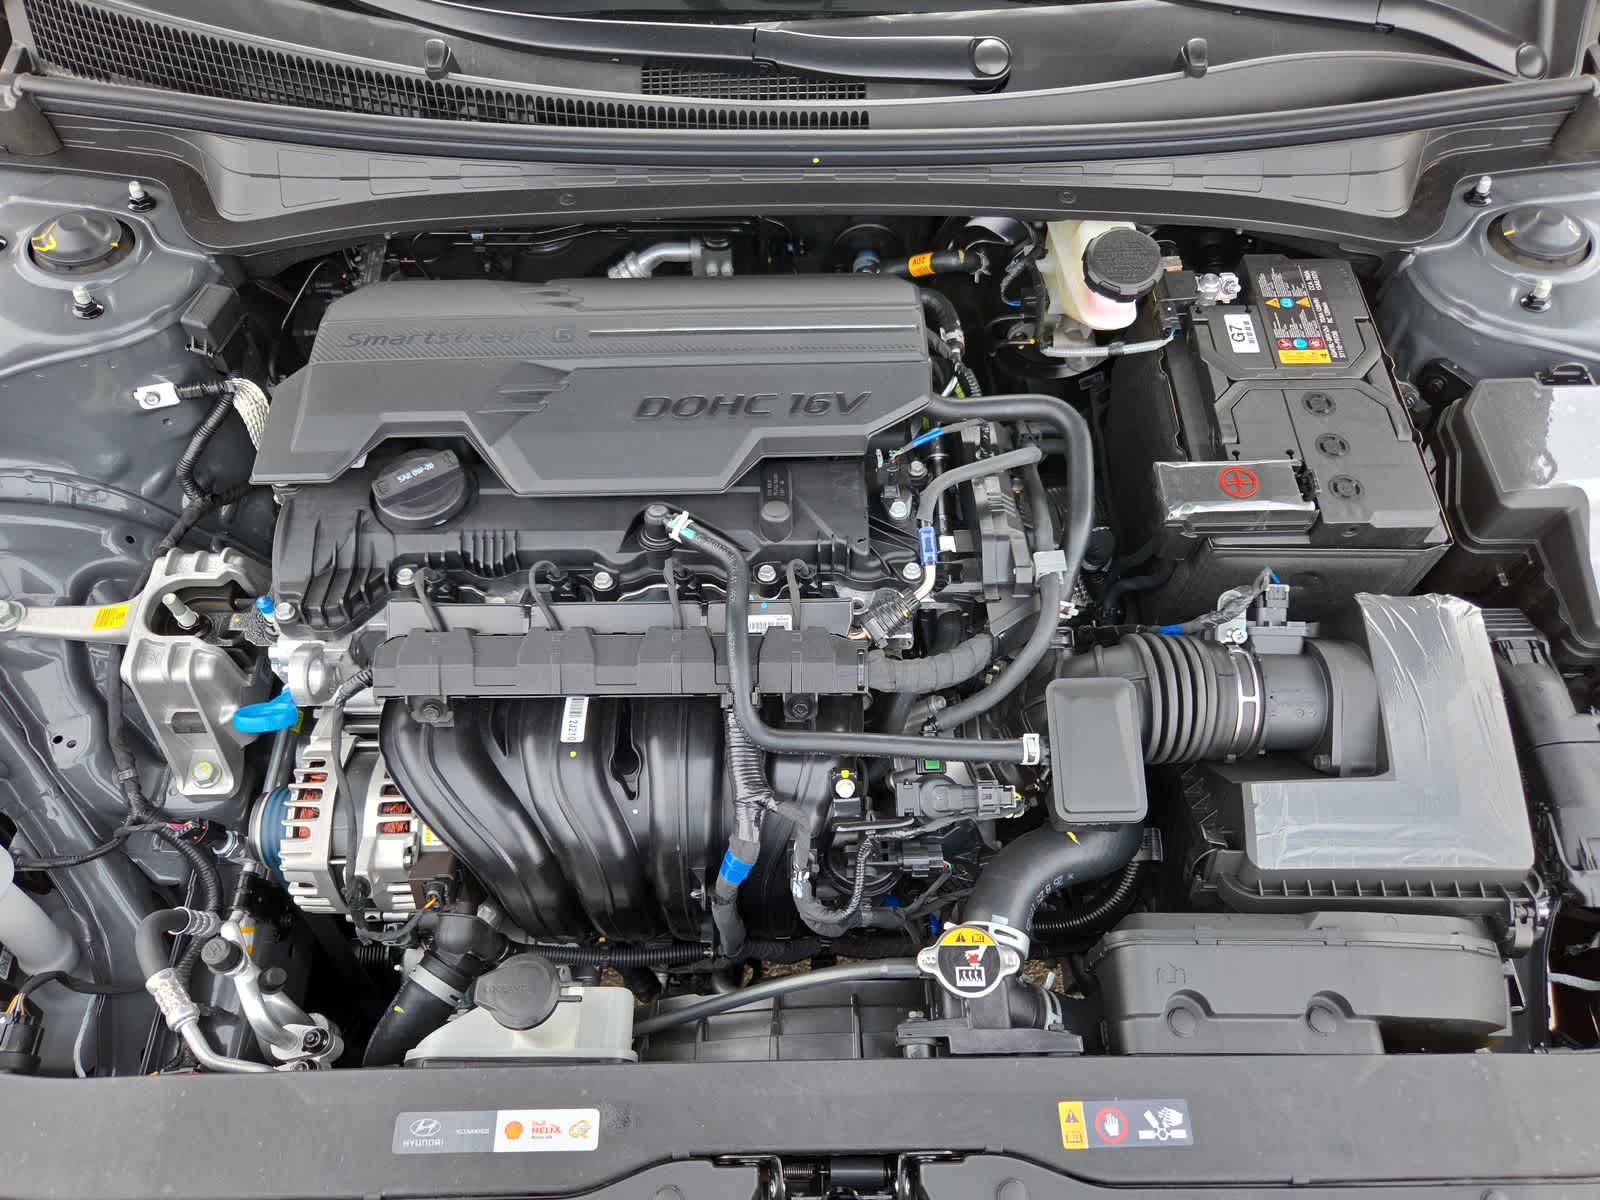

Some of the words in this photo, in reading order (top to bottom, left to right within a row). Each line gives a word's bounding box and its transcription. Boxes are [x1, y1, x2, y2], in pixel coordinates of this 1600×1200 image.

[1231, 325, 1246, 342] G7
[632, 393, 777, 419] DOHC
[788, 391, 873, 416] 16V
[531, 1126, 562, 1135] HELIX
[402, 1137, 444, 1147] HYUNDAI
